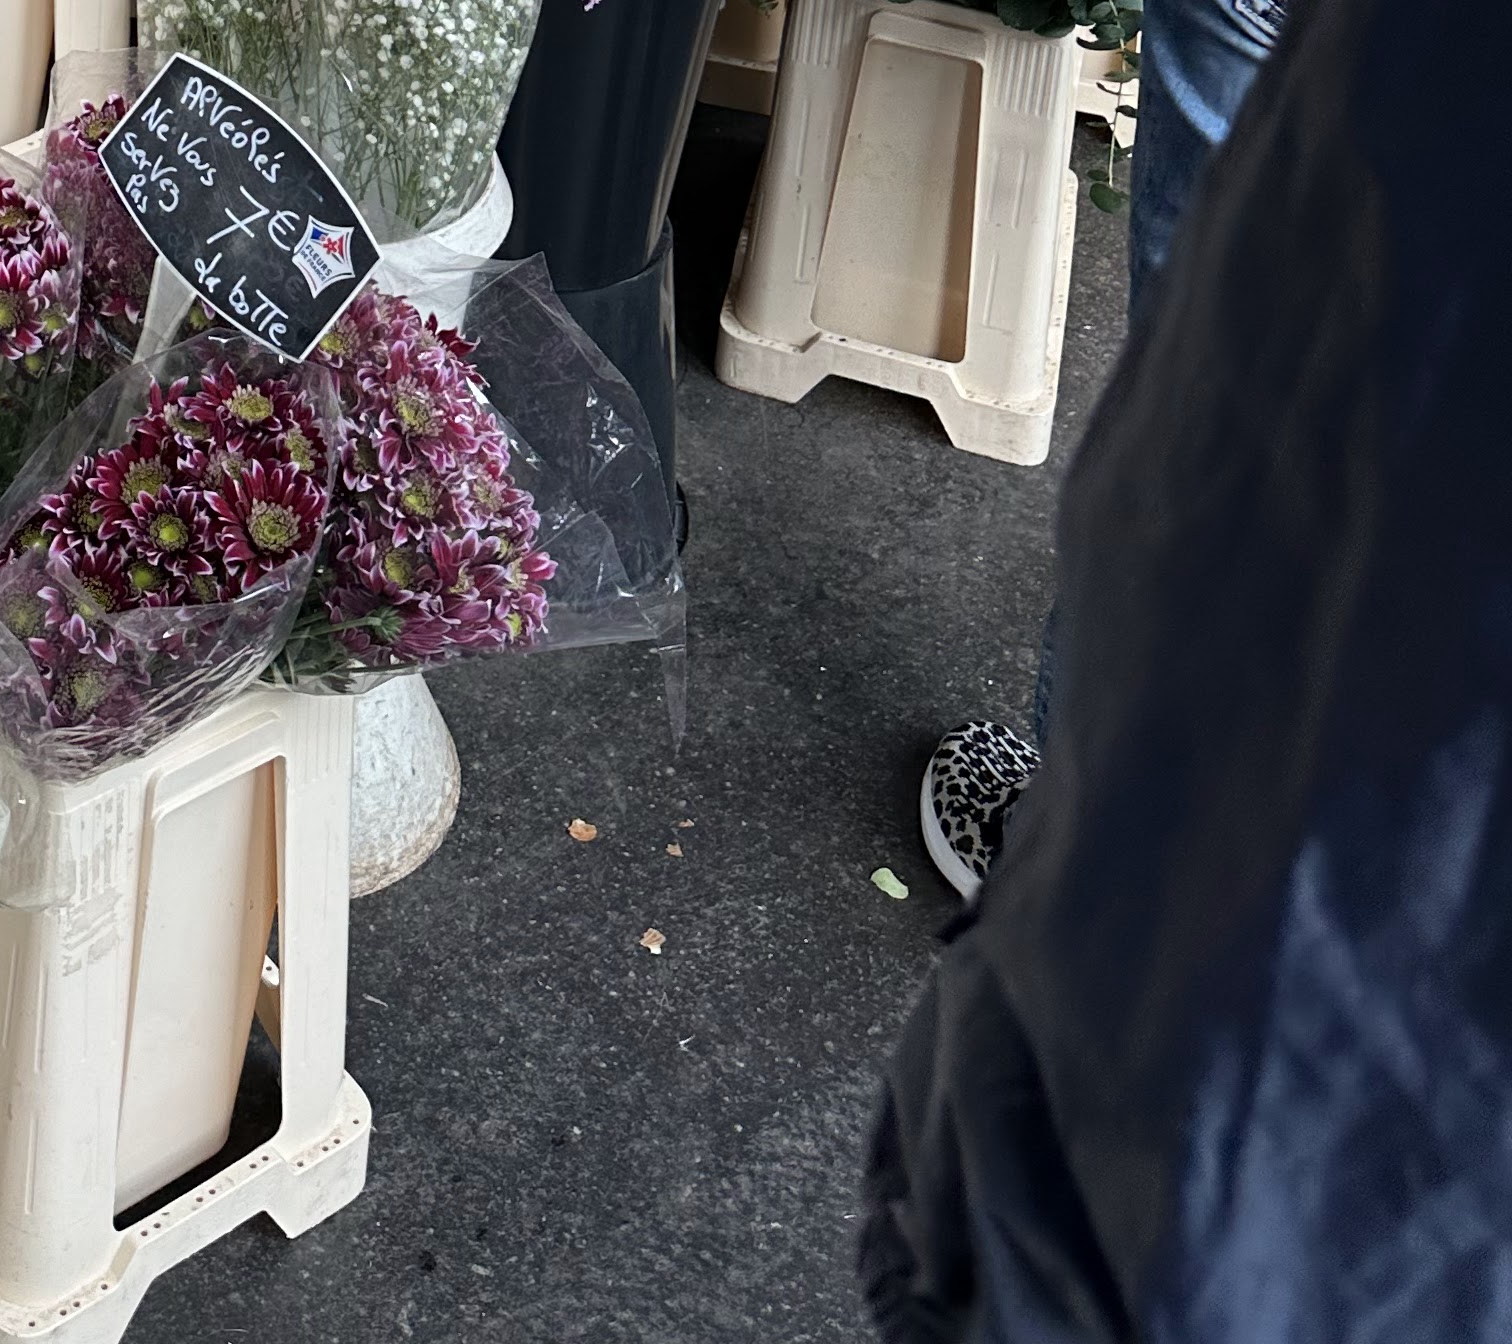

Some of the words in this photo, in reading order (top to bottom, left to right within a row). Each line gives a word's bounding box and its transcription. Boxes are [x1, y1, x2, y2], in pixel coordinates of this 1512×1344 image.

[141, 97, 174, 142] Ne
[177, 132, 216, 186] Vous
[207, 185, 270, 244] 7
[267, 210, 300, 251] €
[306, 244, 333, 277] FLEURS
